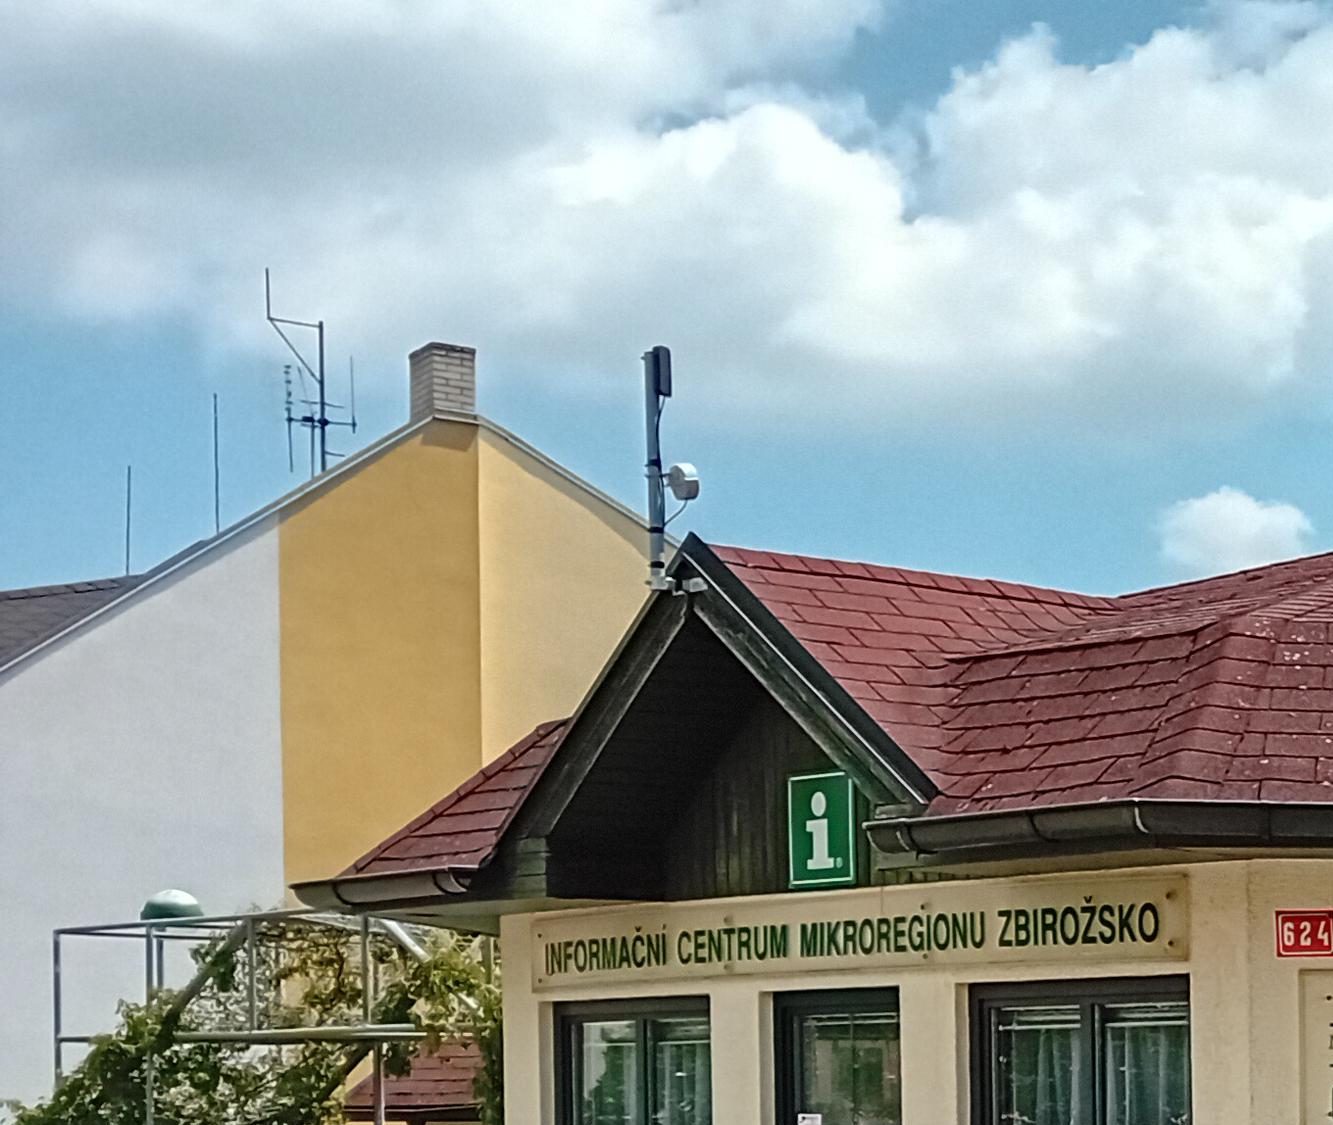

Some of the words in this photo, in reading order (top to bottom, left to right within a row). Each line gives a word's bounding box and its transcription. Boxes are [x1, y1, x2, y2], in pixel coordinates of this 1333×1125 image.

[545, 923, 668, 975] INFORMAČNÍ
[677, 924, 788, 964] CENTRUM
[799, 911, 986, 957] MIKROREGIONU
[997, 895, 1160, 947] ZBIROŽSKO
[1283, 920, 1329, 946] 624
